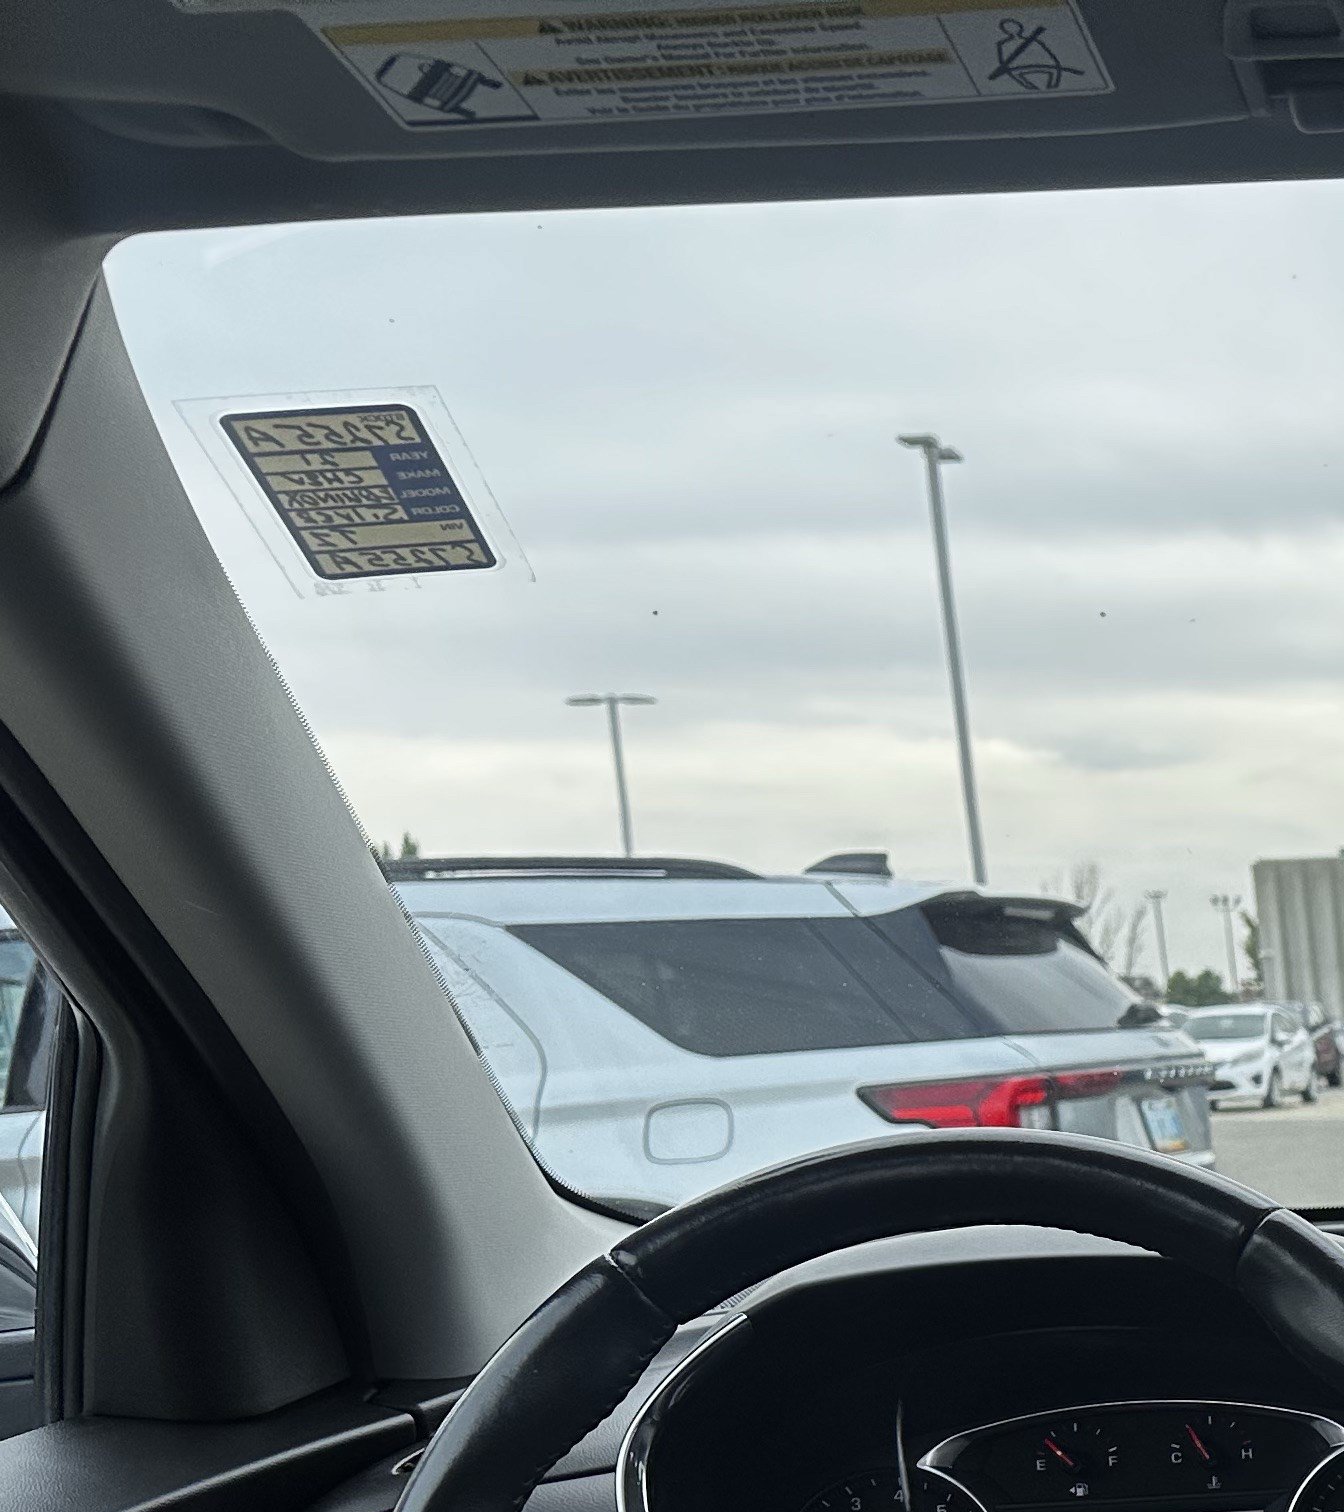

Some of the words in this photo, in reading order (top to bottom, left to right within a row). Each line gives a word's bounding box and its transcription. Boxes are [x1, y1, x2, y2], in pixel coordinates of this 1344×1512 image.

[1171, 1451, 1182, 1464] C
[1241, 1447, 1253, 1460] H
[1036, 1458, 1046, 1471] E
[1108, 1454, 1118, 1467] F
[893, 1489, 905, 1501] 4
[850, 1497, 861, 1511] 3
